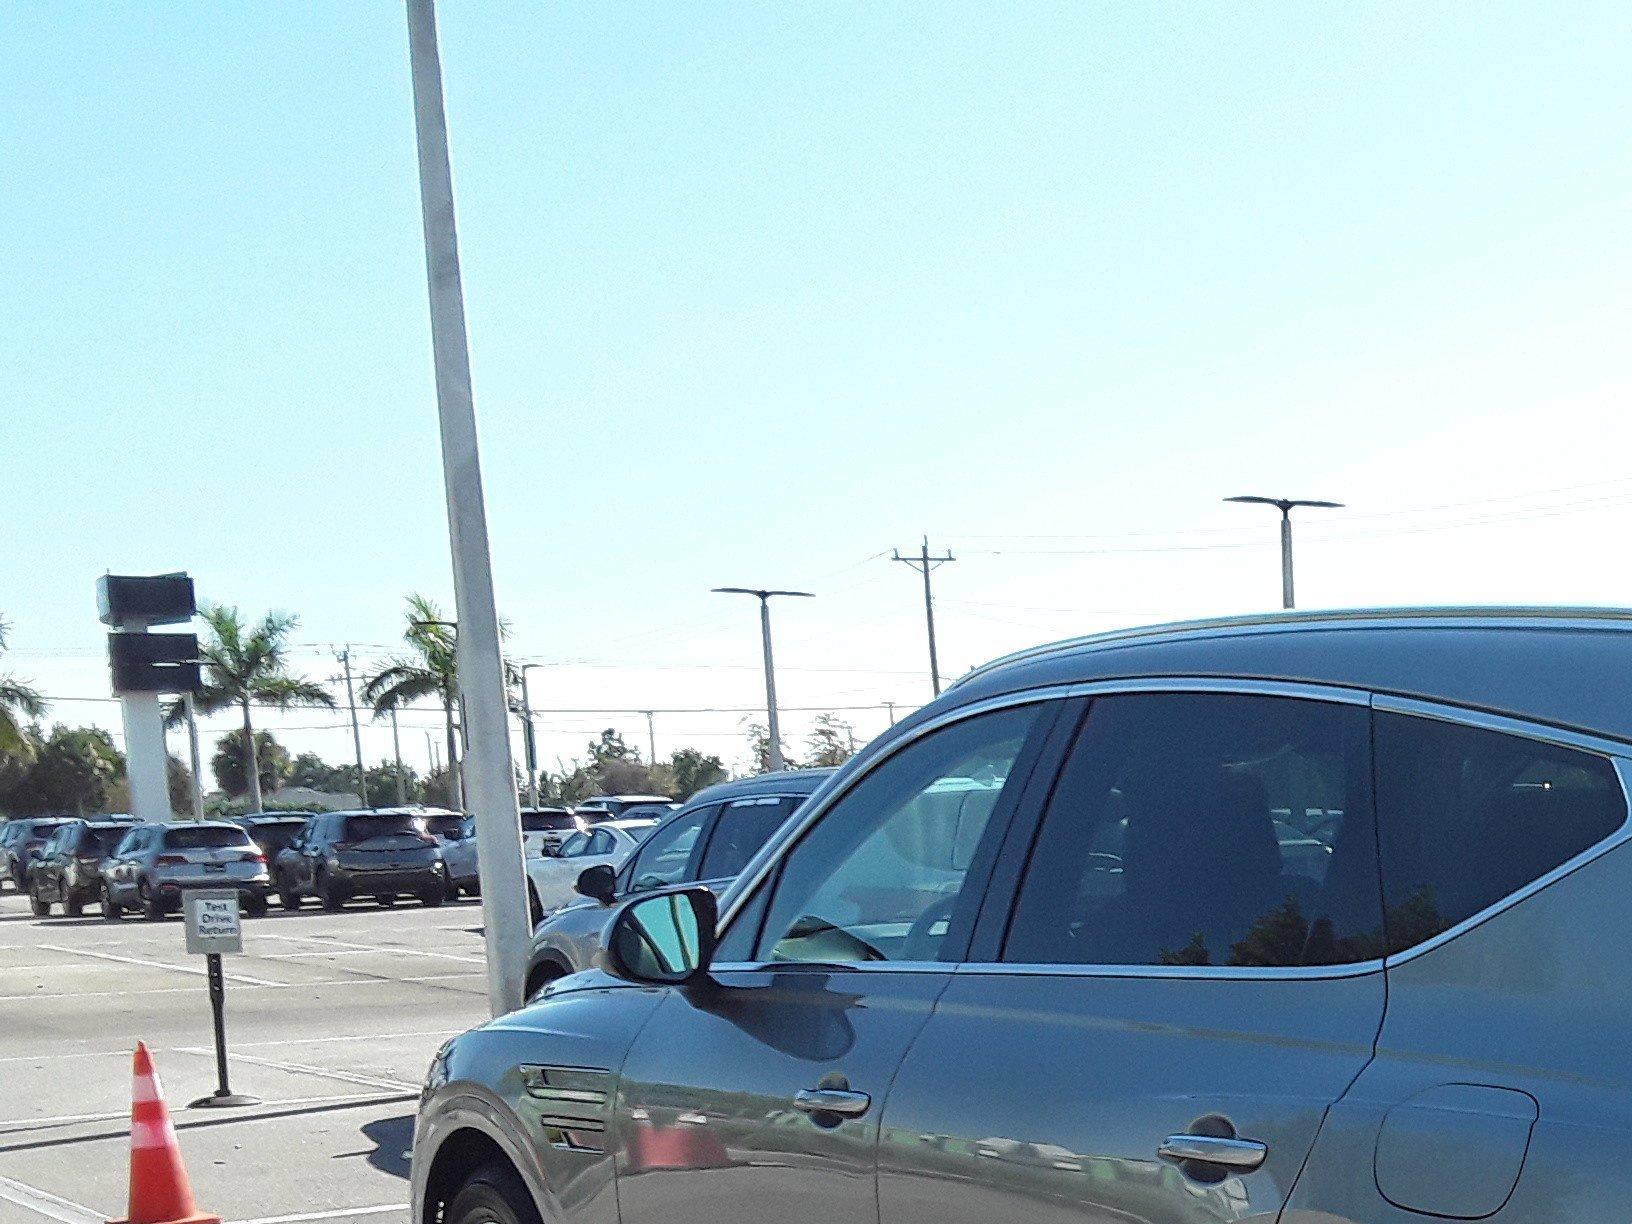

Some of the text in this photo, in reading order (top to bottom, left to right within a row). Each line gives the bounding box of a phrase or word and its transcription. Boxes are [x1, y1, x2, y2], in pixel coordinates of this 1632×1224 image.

[204, 902, 228, 911] Test
[202, 914, 231, 923] Drive
[199, 925, 237, 934] Return
